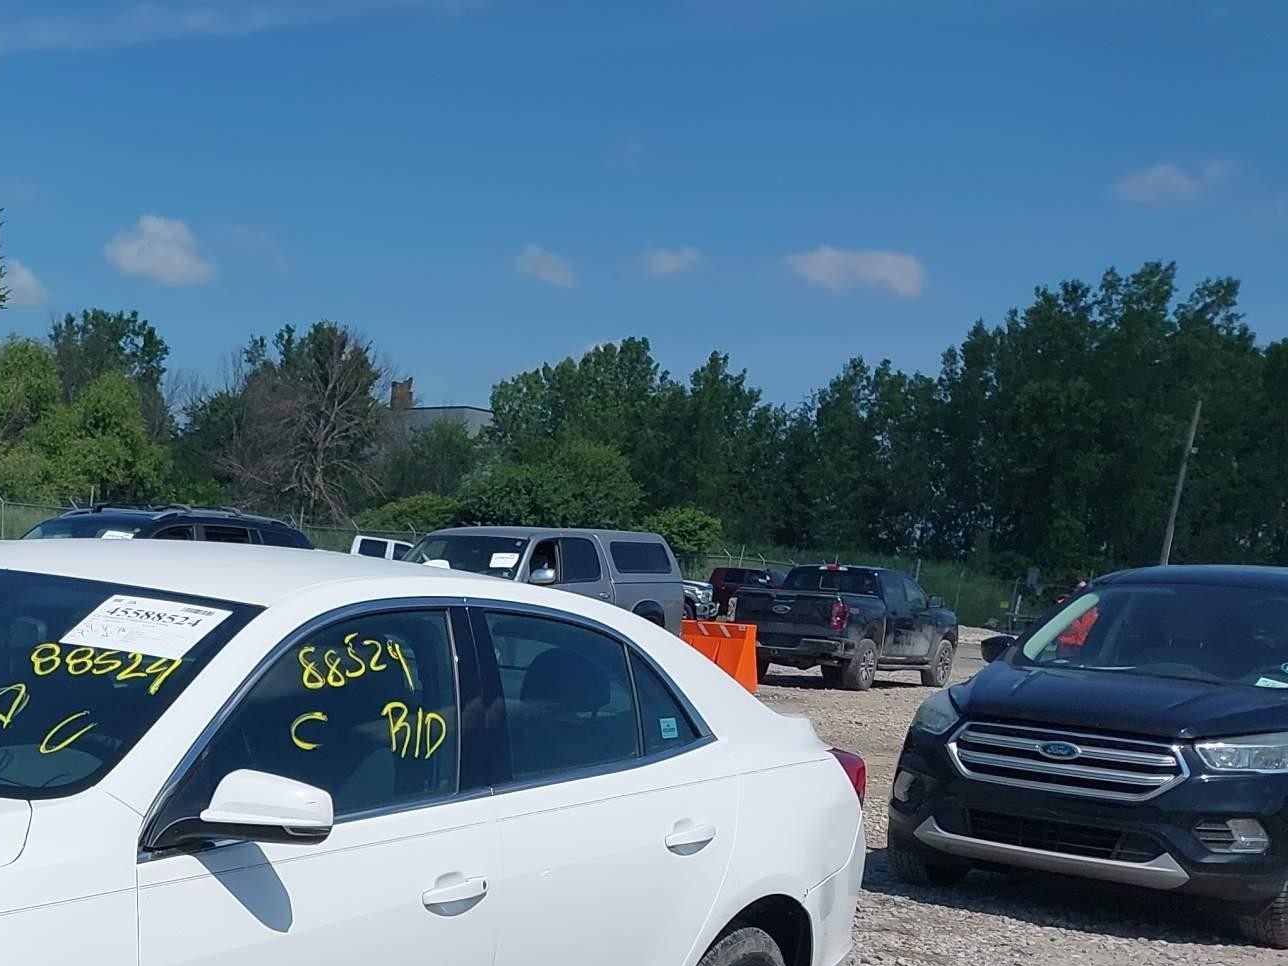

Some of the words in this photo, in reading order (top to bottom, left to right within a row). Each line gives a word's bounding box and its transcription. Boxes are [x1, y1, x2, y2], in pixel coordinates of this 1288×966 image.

[106, 606, 203, 628] 45588524
[30, 642, 182, 695] 88524
[297, 632, 414, 693] 88524
[290, 711, 328, 750] C
